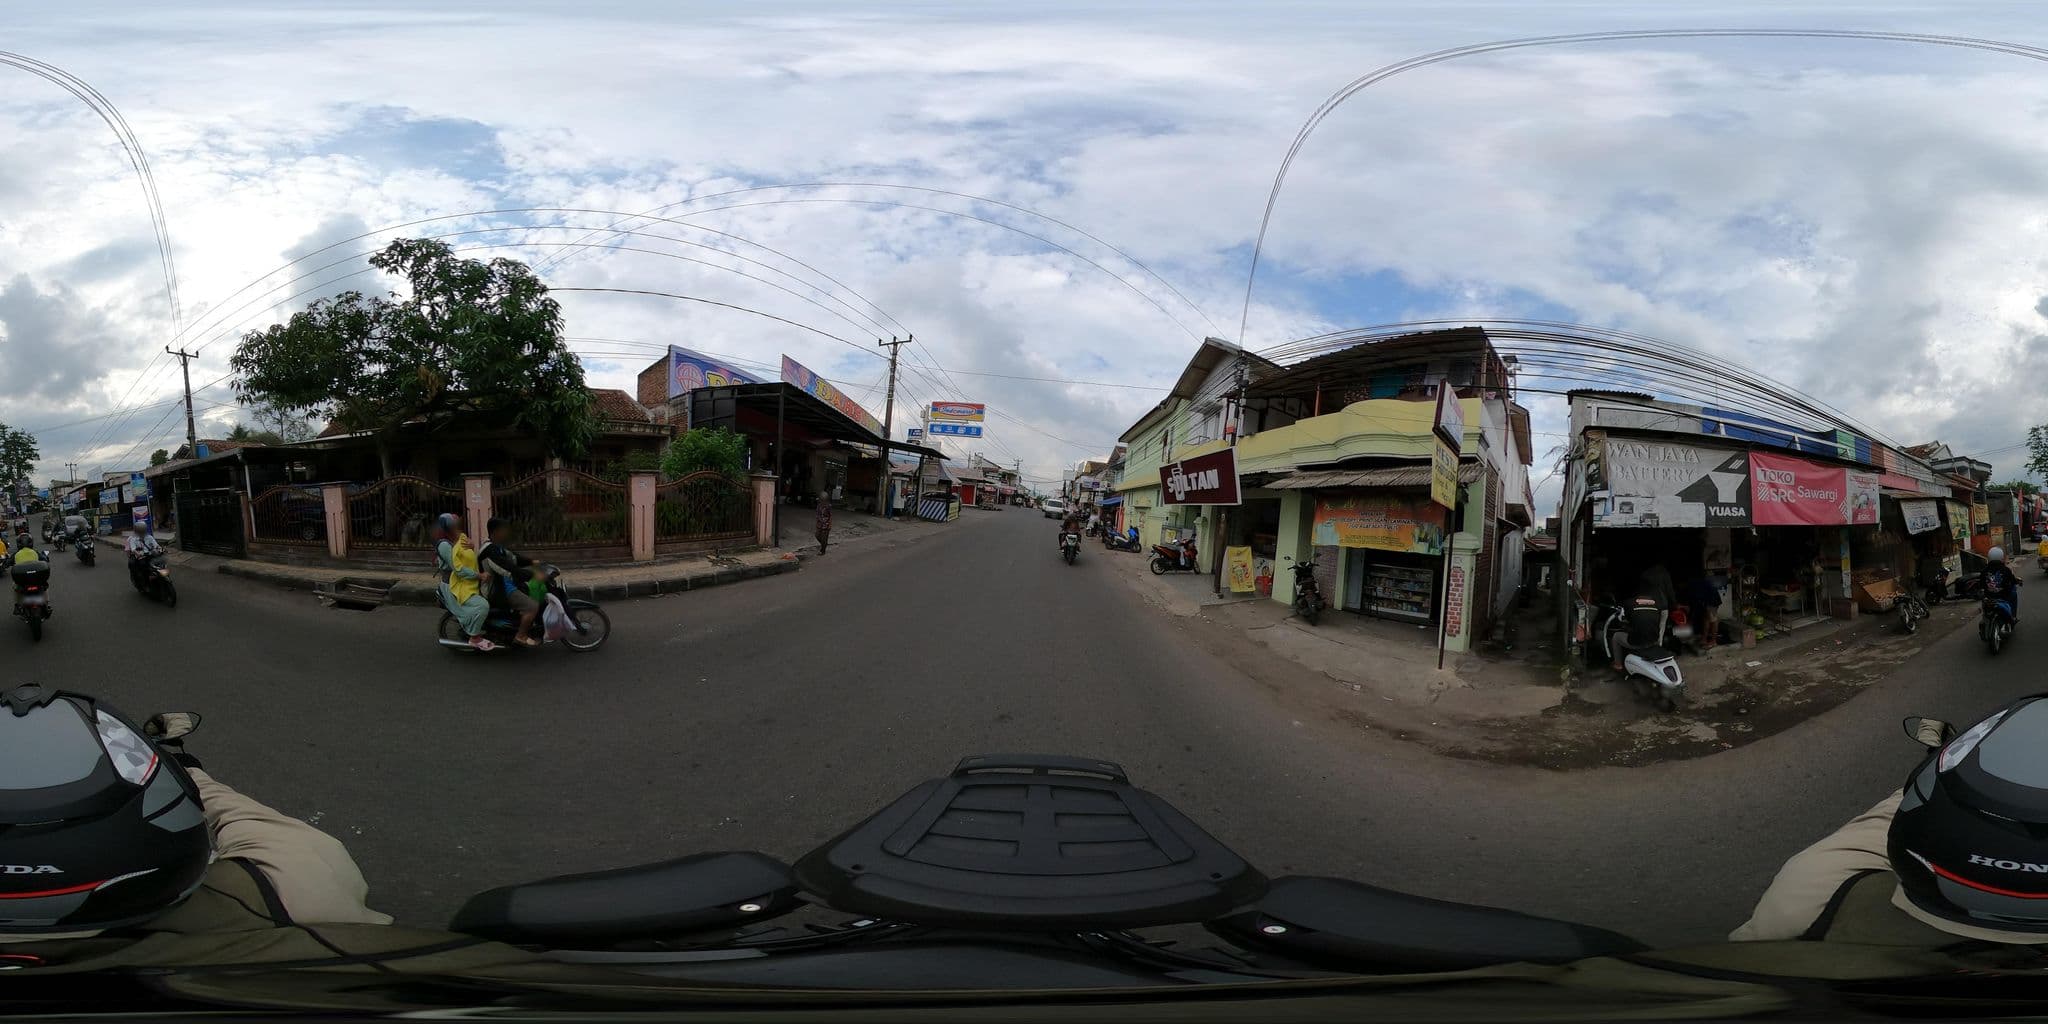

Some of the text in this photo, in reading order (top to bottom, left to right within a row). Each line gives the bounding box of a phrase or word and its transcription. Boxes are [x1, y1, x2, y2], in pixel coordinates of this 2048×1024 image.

[1607, 442, 1701, 463] WAN JAYA
[1614, 464, 1696, 482] BATTERY
[1761, 469, 1793, 484] TOKO
[1167, 467, 1220, 501] SULTAN
[1770, 485, 1838, 503] SRC Sawargi
[1709, 505, 1746, 517] YUASA
[0, 865, 64, 874] DA
